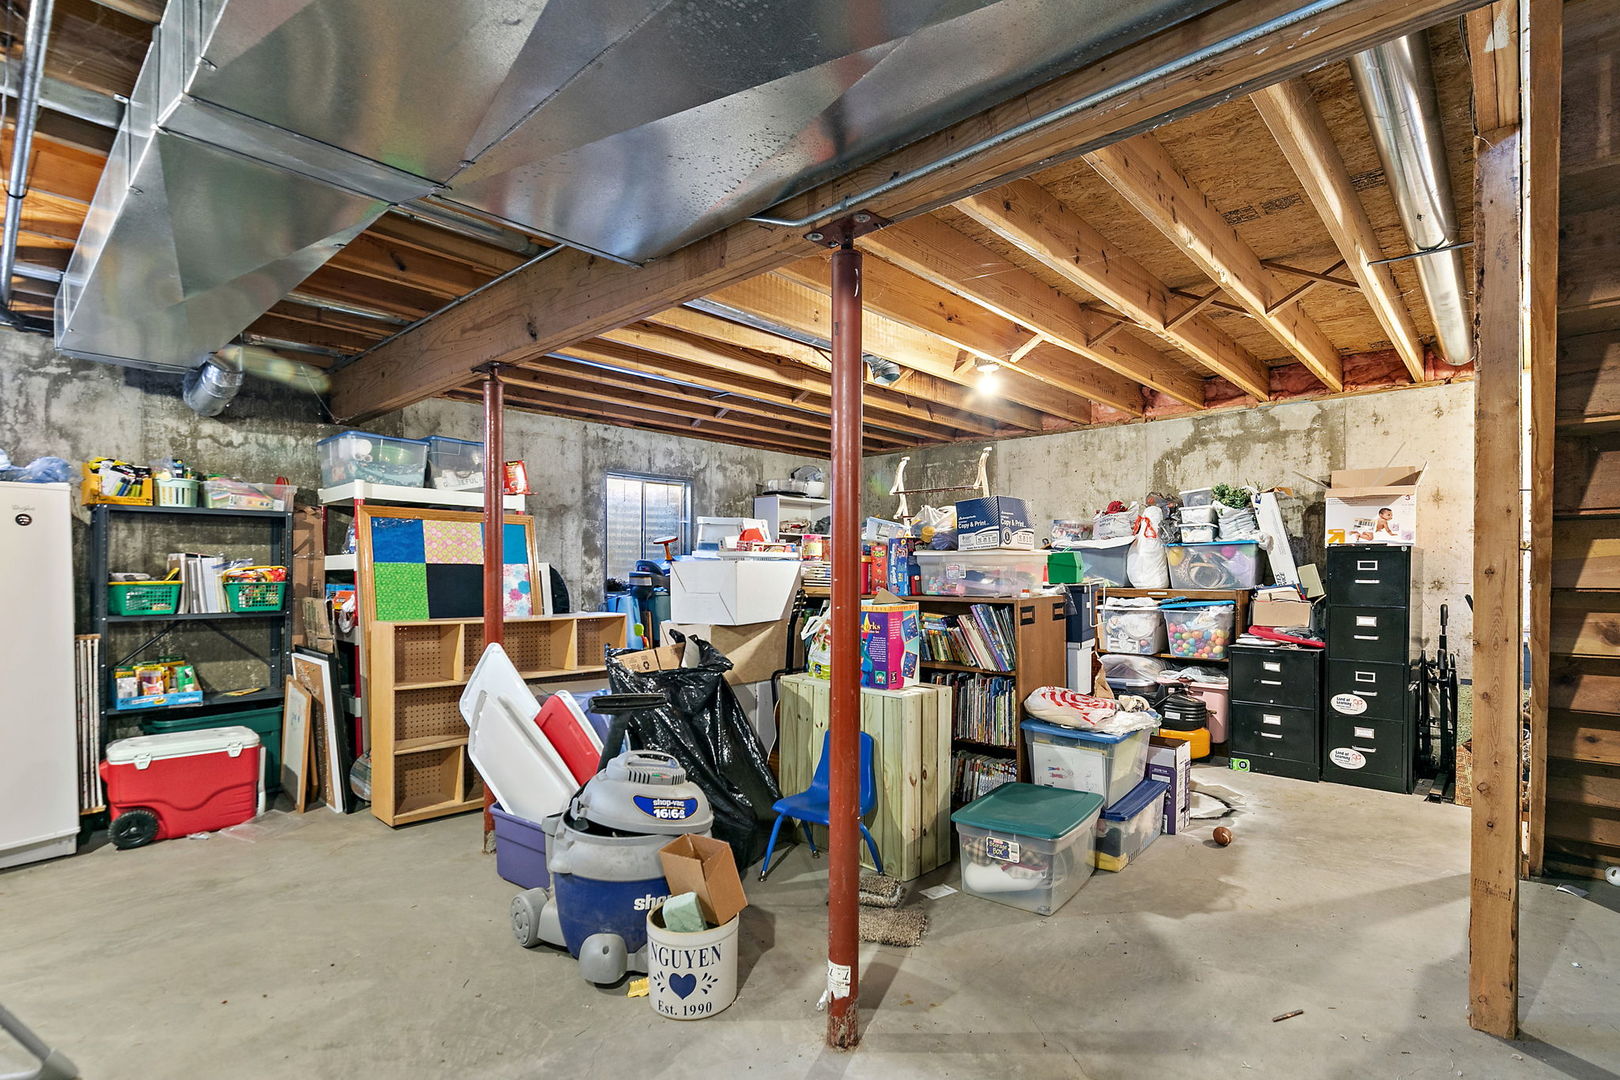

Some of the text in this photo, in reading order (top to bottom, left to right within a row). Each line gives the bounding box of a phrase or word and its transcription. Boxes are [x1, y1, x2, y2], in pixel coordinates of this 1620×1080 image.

[1001, 519, 1011, 527] Copy
[652, 798, 685, 807] shop-vac
[634, 894, 672, 911] sho
[651, 941, 722, 969] NGUYEN
[658, 1000, 713, 1016] Est. 1990
